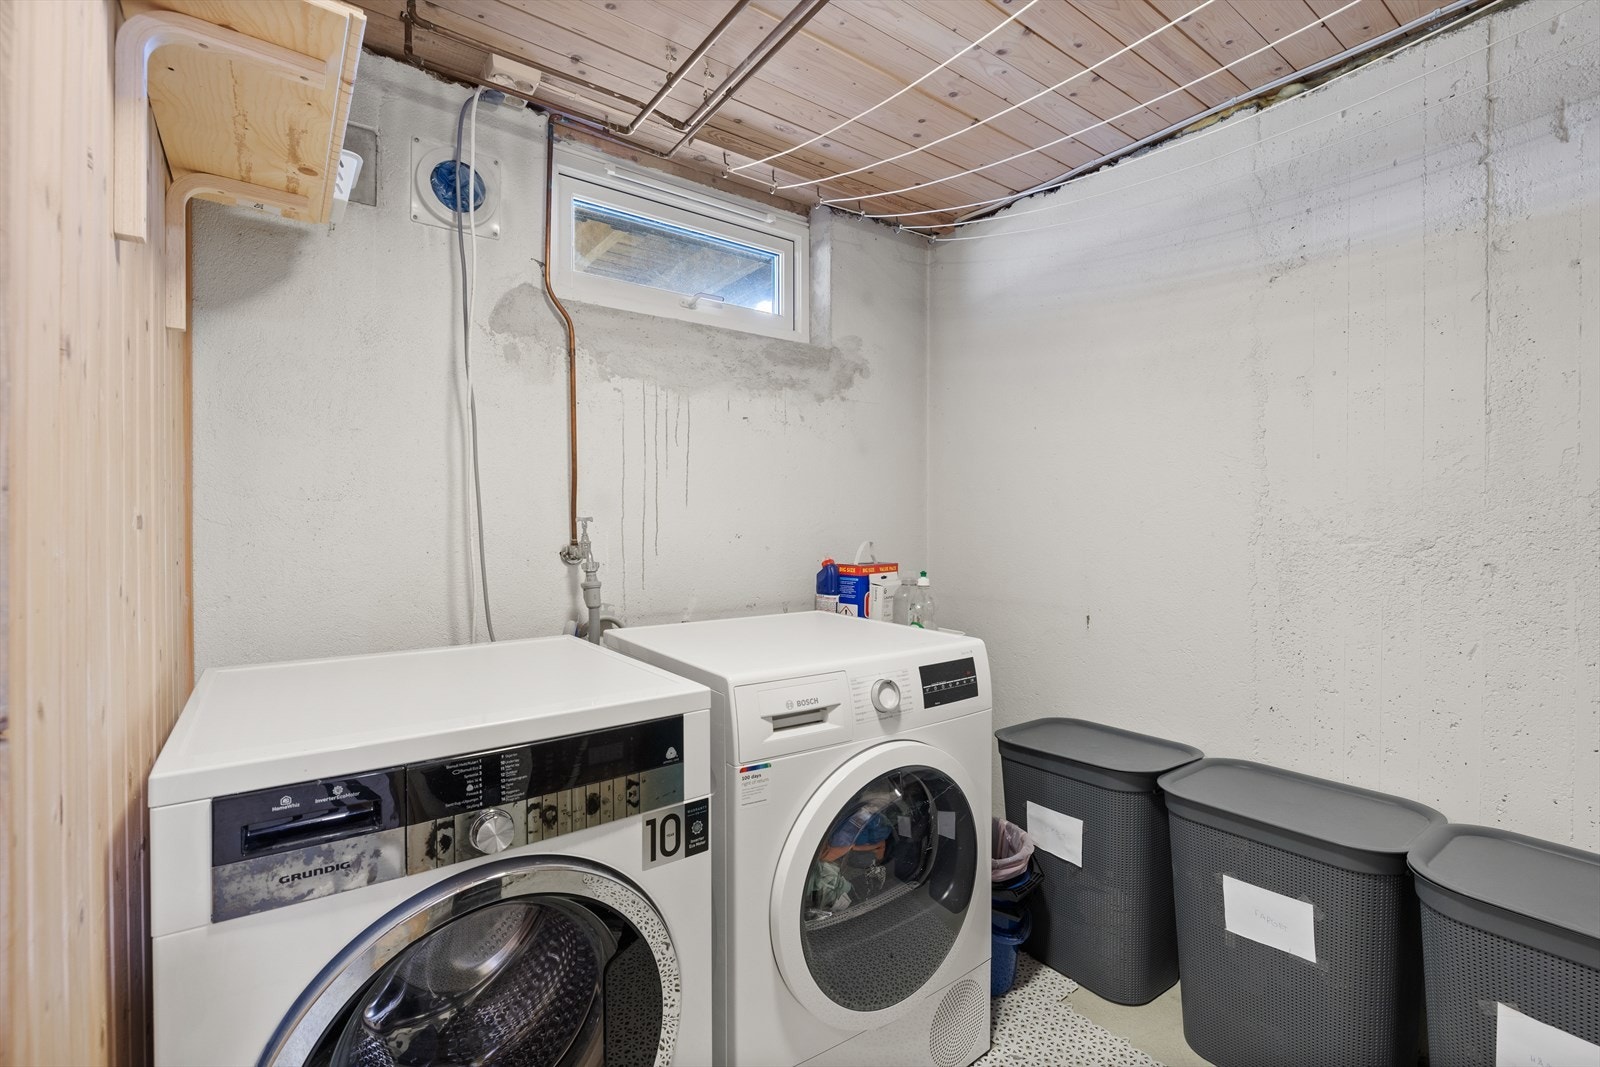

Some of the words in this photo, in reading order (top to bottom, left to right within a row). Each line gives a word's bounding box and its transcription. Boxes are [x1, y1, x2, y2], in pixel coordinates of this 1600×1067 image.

[796, 697, 819, 707] BOSCH
[645, 813, 681, 862] 10
[279, 861, 351, 884] GRUNDIG
